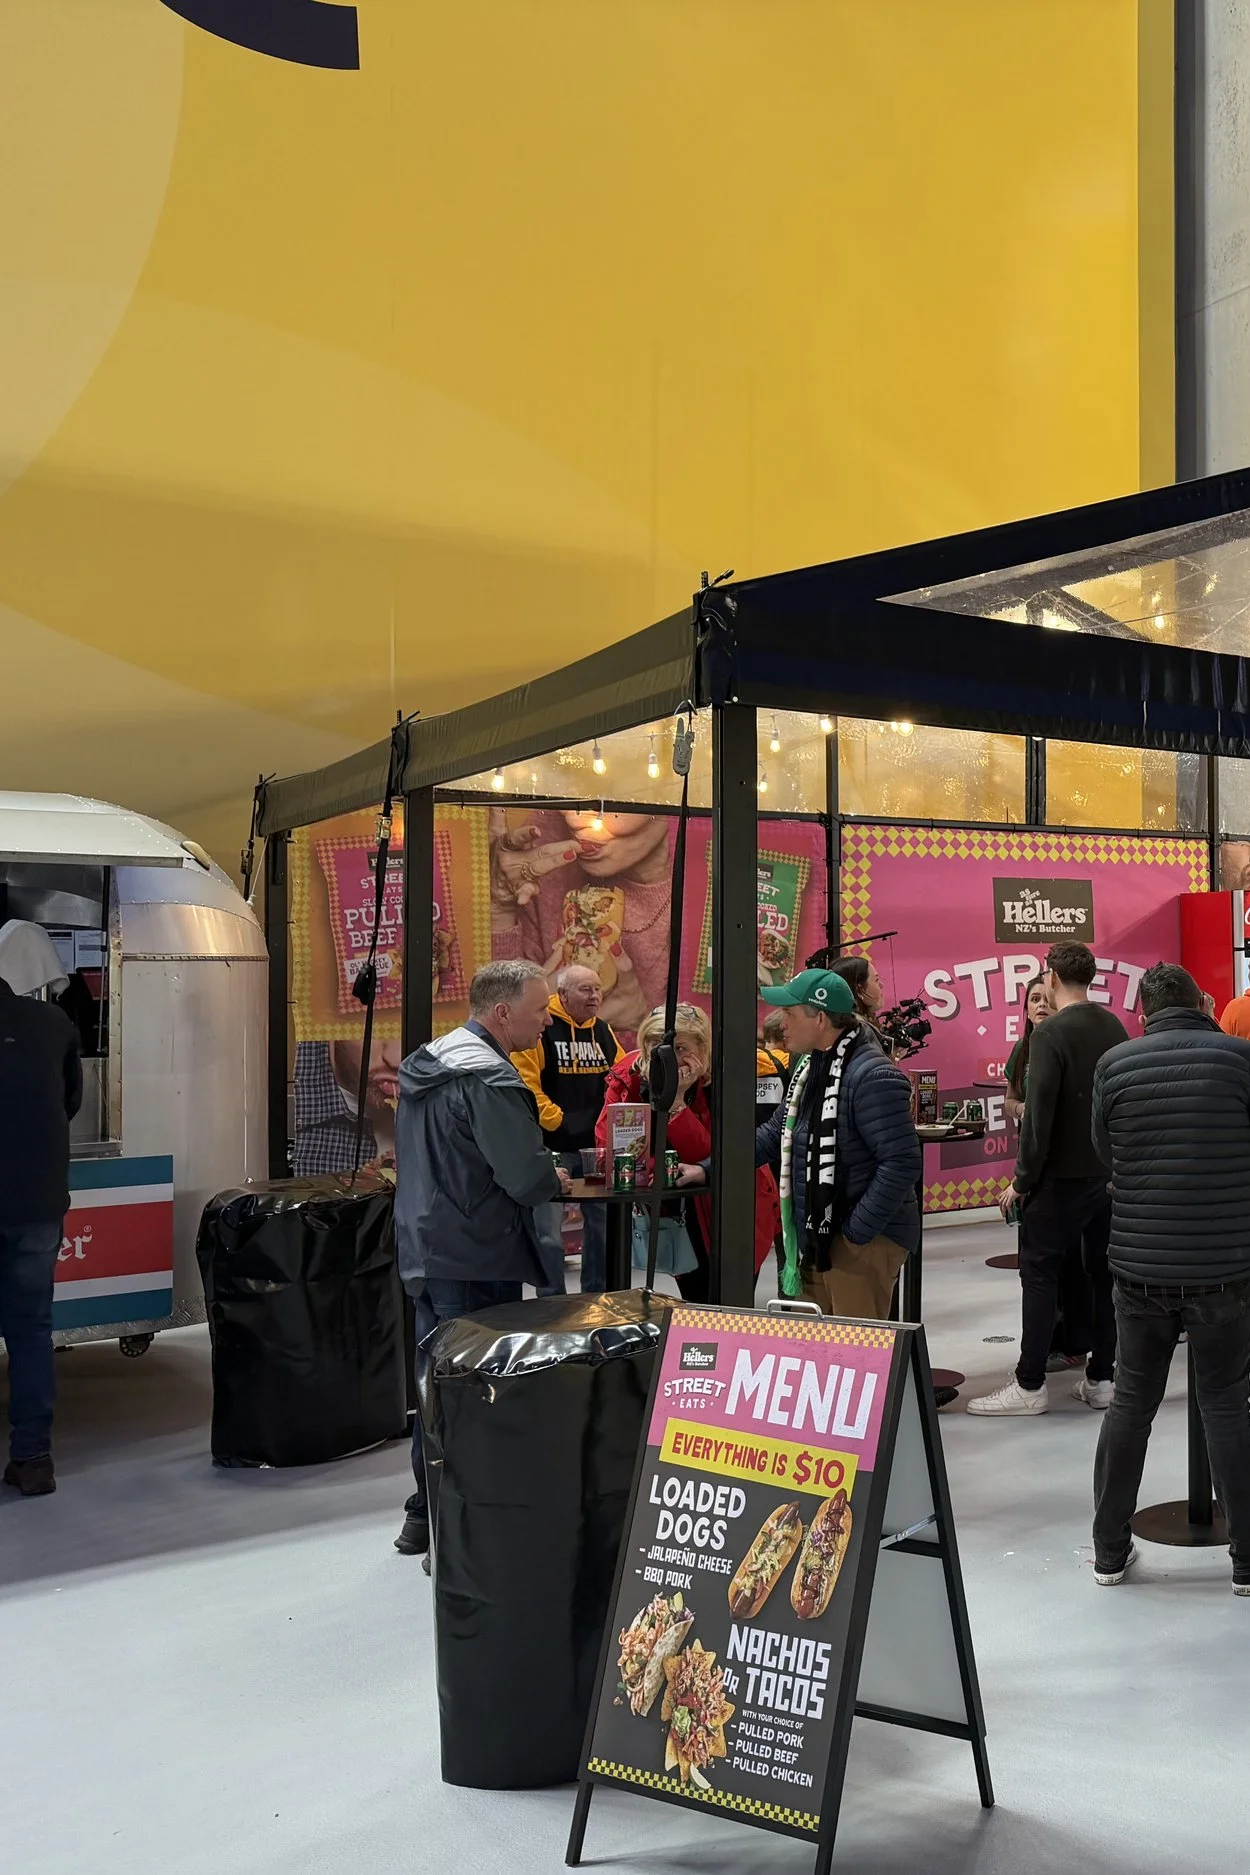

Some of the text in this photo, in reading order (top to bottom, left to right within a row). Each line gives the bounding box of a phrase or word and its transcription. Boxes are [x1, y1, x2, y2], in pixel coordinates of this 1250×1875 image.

[1003, 899, 1087, 924] Hellers
[349, 928, 397, 948] BEEF
[1015, 924, 1076, 933] NZ's Butcher
[924, 954, 1146, 1018] STRET
[554, 1041, 570, 1060] TE
[984, 1135, 1008, 1156] ON
[683, 1351, 715, 1362] Hellers
[664, 1377, 727, 1397] STREET
[724, 1348, 878, 1440] MENU
[680, 1399, 706, 1409] EATS
[672, 1432, 845, 1488] EVERYTHING IS $10
[649, 1474, 747, 1518] LOADED
[656, 1510, 728, 1550] DOGS
[647, 1546, 695, 1568] JALAPEÑO
[697, 1555, 733, 1575] CHEESE
[643, 1568, 665, 1585] BBQ
[665, 1570, 693, 1590] PORK
[726, 1623, 832, 1680] NACHOS
[723, 1666, 827, 1720] OR TACOS
[742, 1709, 804, 1730] WITH YOUR CHOICE OF
[738, 1722, 775, 1742] PULLED
[776, 1730, 804, 1749] PORK
[735, 1739, 772, 1759] PULLED
[773, 1748, 799, 1765] BEEF
[732, 1756, 770, 1777] PULLED
[771, 1766, 814, 1788] CHICKEN
